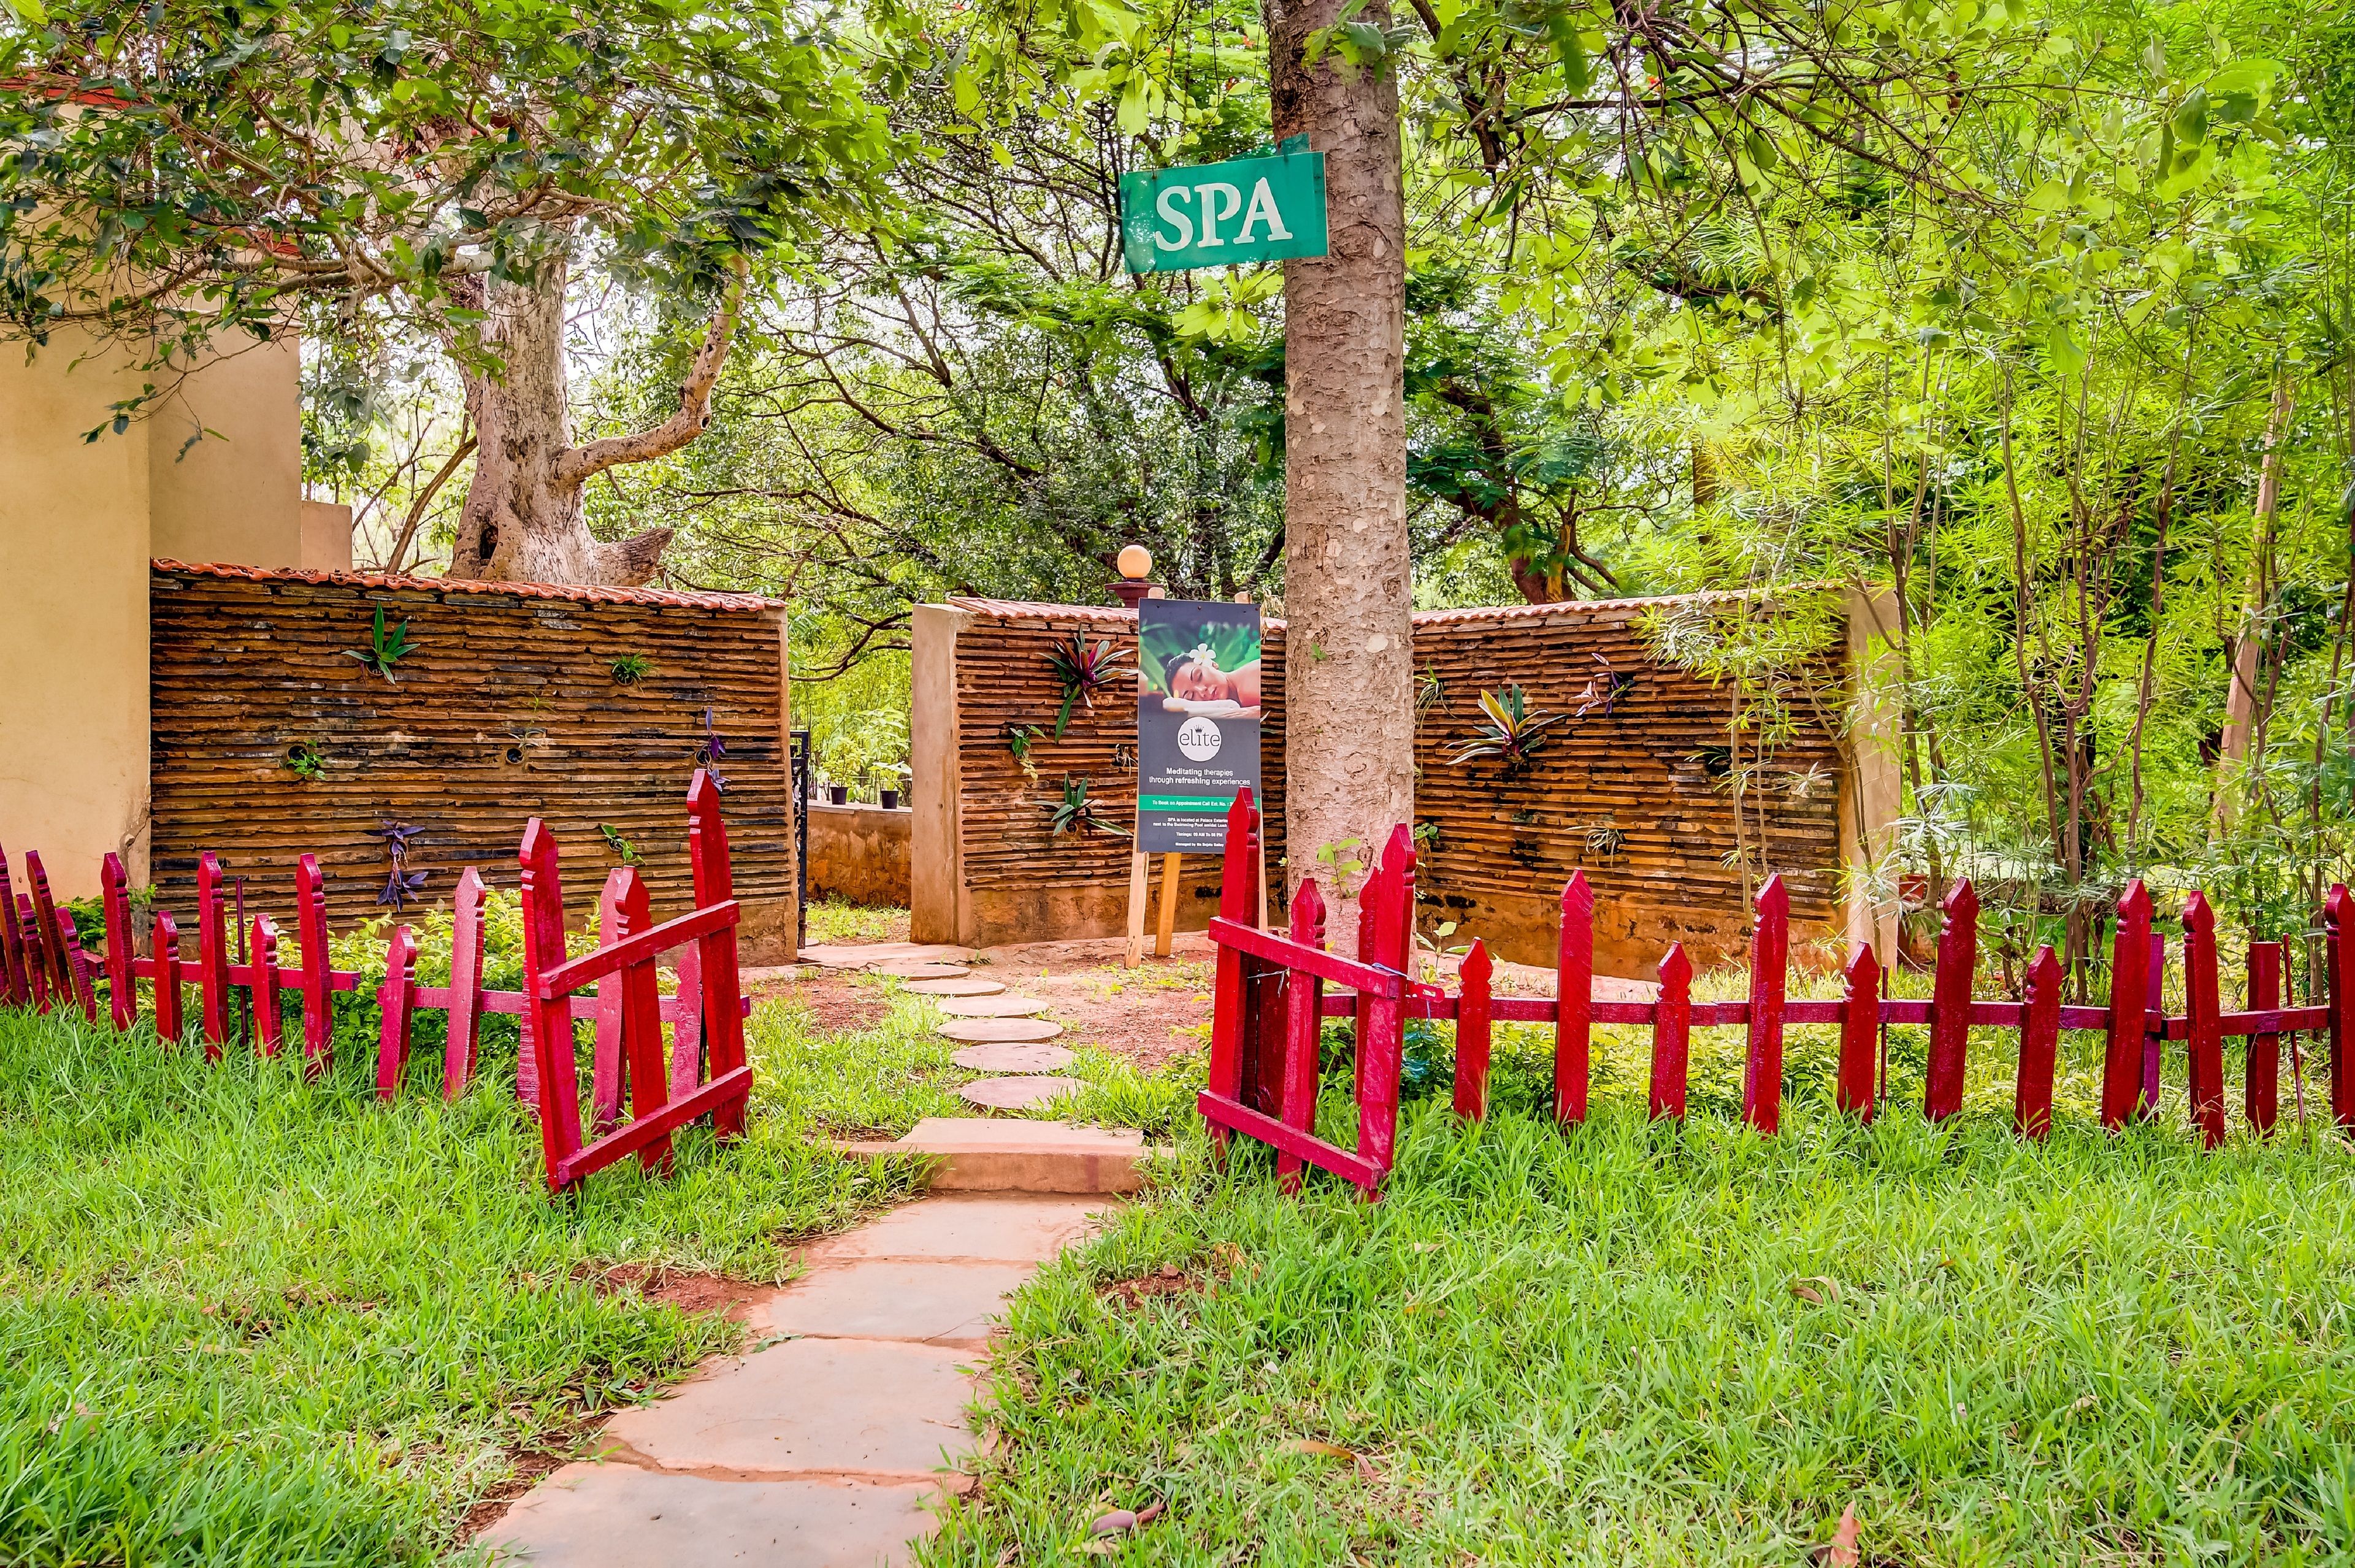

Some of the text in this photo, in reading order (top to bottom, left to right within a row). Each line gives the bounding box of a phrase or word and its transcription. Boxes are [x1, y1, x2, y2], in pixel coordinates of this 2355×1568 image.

[1155, 177, 1293, 251] SPA
[1179, 729, 1220, 746] elite
[1166, 767, 1233, 778] Meditating therapies
[1175, 777, 1210, 786] refreshing
